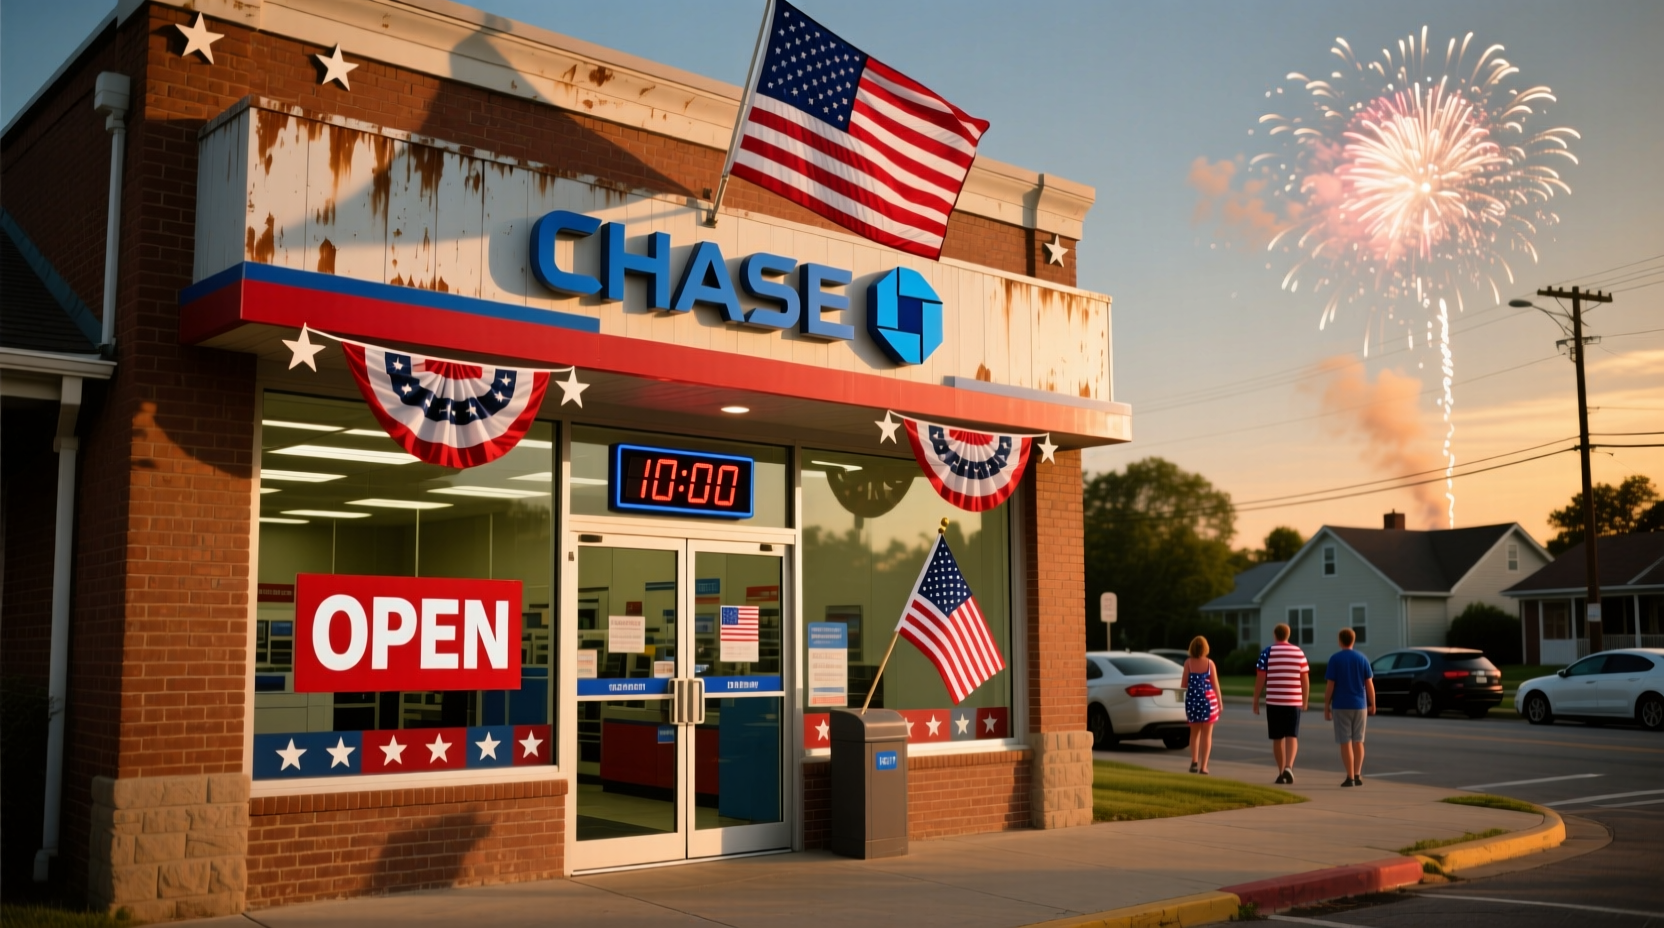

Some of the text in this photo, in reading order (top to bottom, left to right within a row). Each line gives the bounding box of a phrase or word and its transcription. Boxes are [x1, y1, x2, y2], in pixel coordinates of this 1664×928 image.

[531, 211, 854, 342] CHASE
[641, 459, 739, 506] 10:00
[313, 595, 509, 671] OPEN
